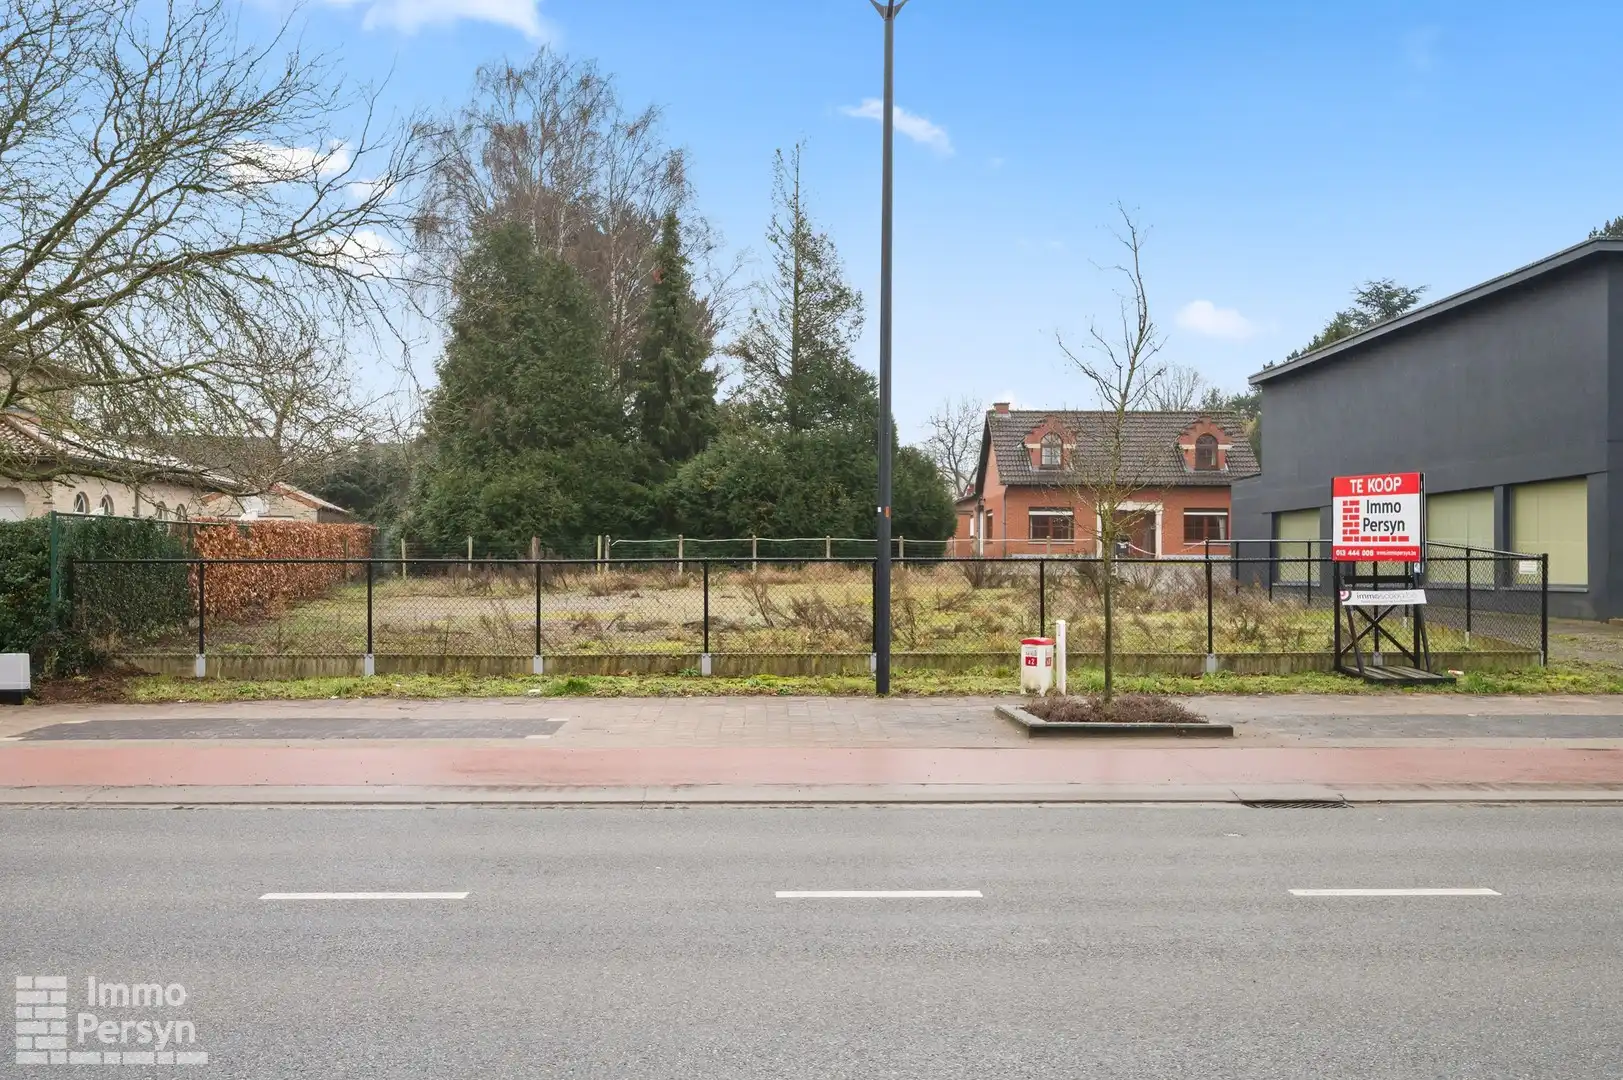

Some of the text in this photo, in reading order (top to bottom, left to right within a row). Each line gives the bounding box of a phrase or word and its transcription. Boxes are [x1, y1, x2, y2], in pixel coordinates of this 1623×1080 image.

[1350, 477, 1402, 493] TE KOOP
[1366, 500, 1402, 514] Immo
[1363, 518, 1405, 535] Persyn
[1347, 549, 1360, 557] 444
